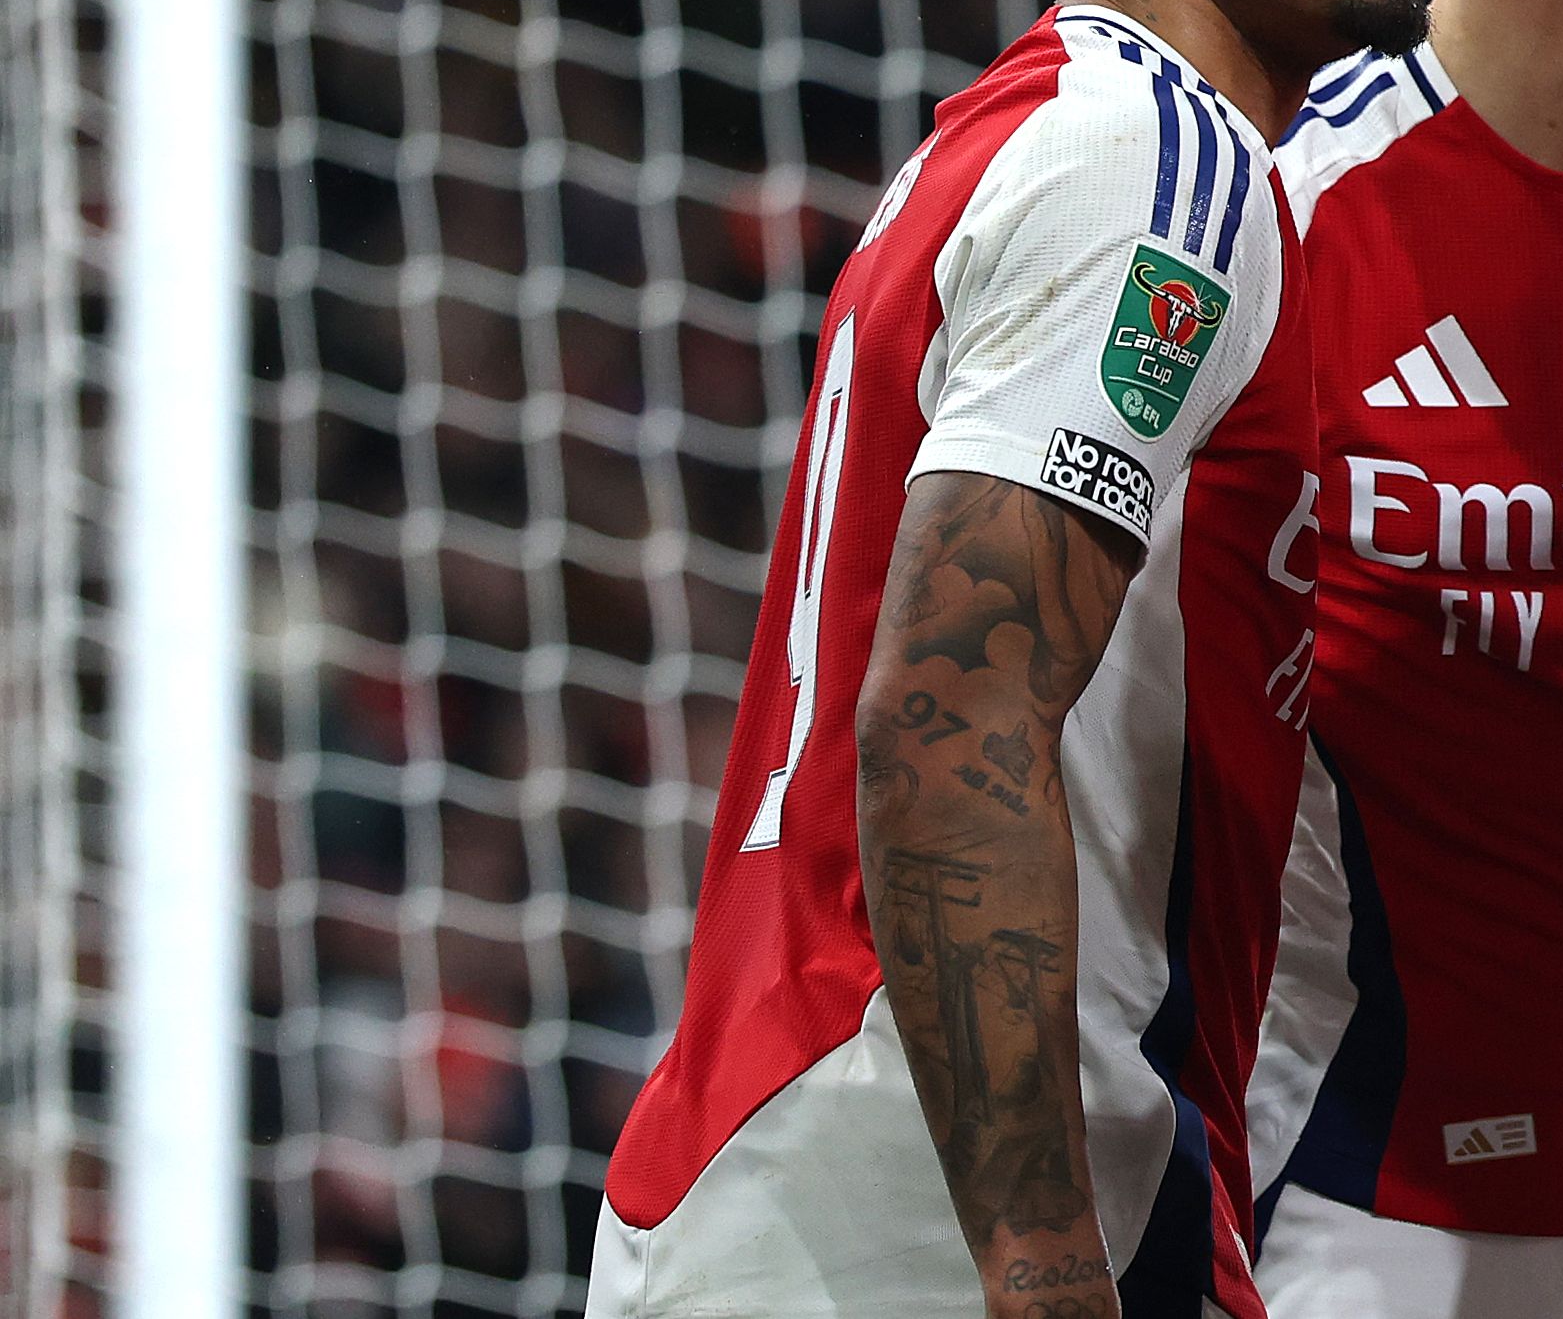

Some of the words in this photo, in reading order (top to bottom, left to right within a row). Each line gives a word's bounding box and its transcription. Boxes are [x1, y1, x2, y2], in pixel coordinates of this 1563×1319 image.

[1114, 327, 1200, 369] Carabao
[1137, 354, 1173, 385] Cup
[1142, 403, 1160, 429] EFL
[1049, 430, 1099, 470] No
[1042, 456, 1092, 494] for
[1439, 588, 1543, 673] FLY
[893, 690, 973, 747] 97
